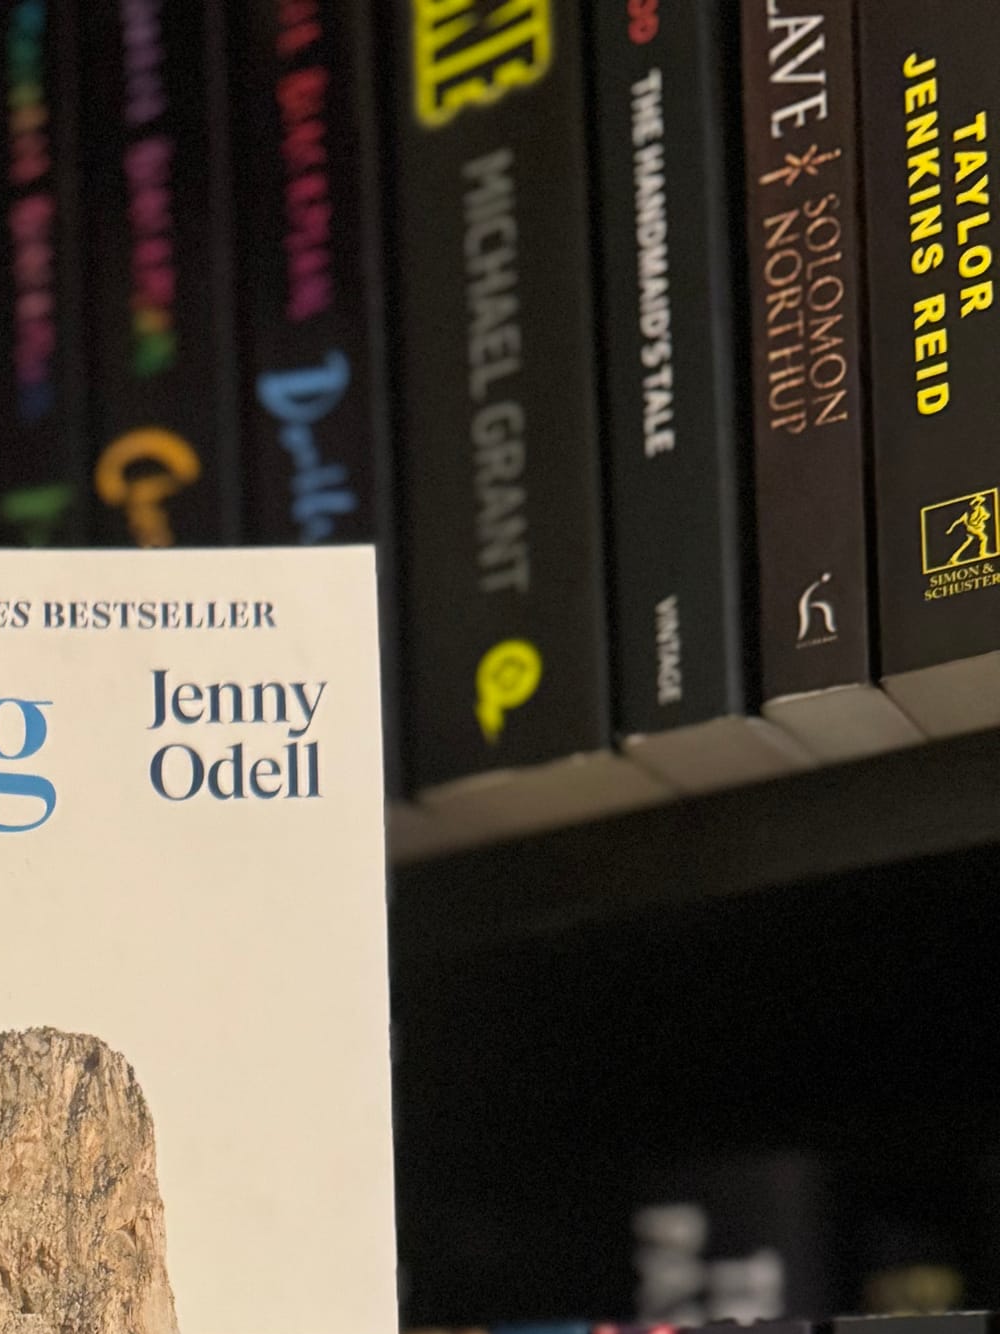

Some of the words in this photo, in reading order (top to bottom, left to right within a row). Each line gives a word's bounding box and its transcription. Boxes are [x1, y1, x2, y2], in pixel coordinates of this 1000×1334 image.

[631, 67, 664, 147] THE
[903, 52, 944, 275] JENKINS
[953, 111, 993, 319] TAYLOR
[463, 147, 521, 399] MICHAEL
[763, 209, 807, 434] NORTHUP
[803, 193, 848, 426] SOLOMON
[914, 293, 949, 415] REID
[643, 365, 675, 458] TALE
[470, 400, 529, 594] GRANT
[43, 601, 277, 631] BESTSELLER
[924, 571, 1000, 601] SCHUSTER
[929, 565, 980, 587] SIMON
[982, 563, 994, 574] &
[147, 668, 328, 736] Jenny
[150, 741, 323, 801] Odell
